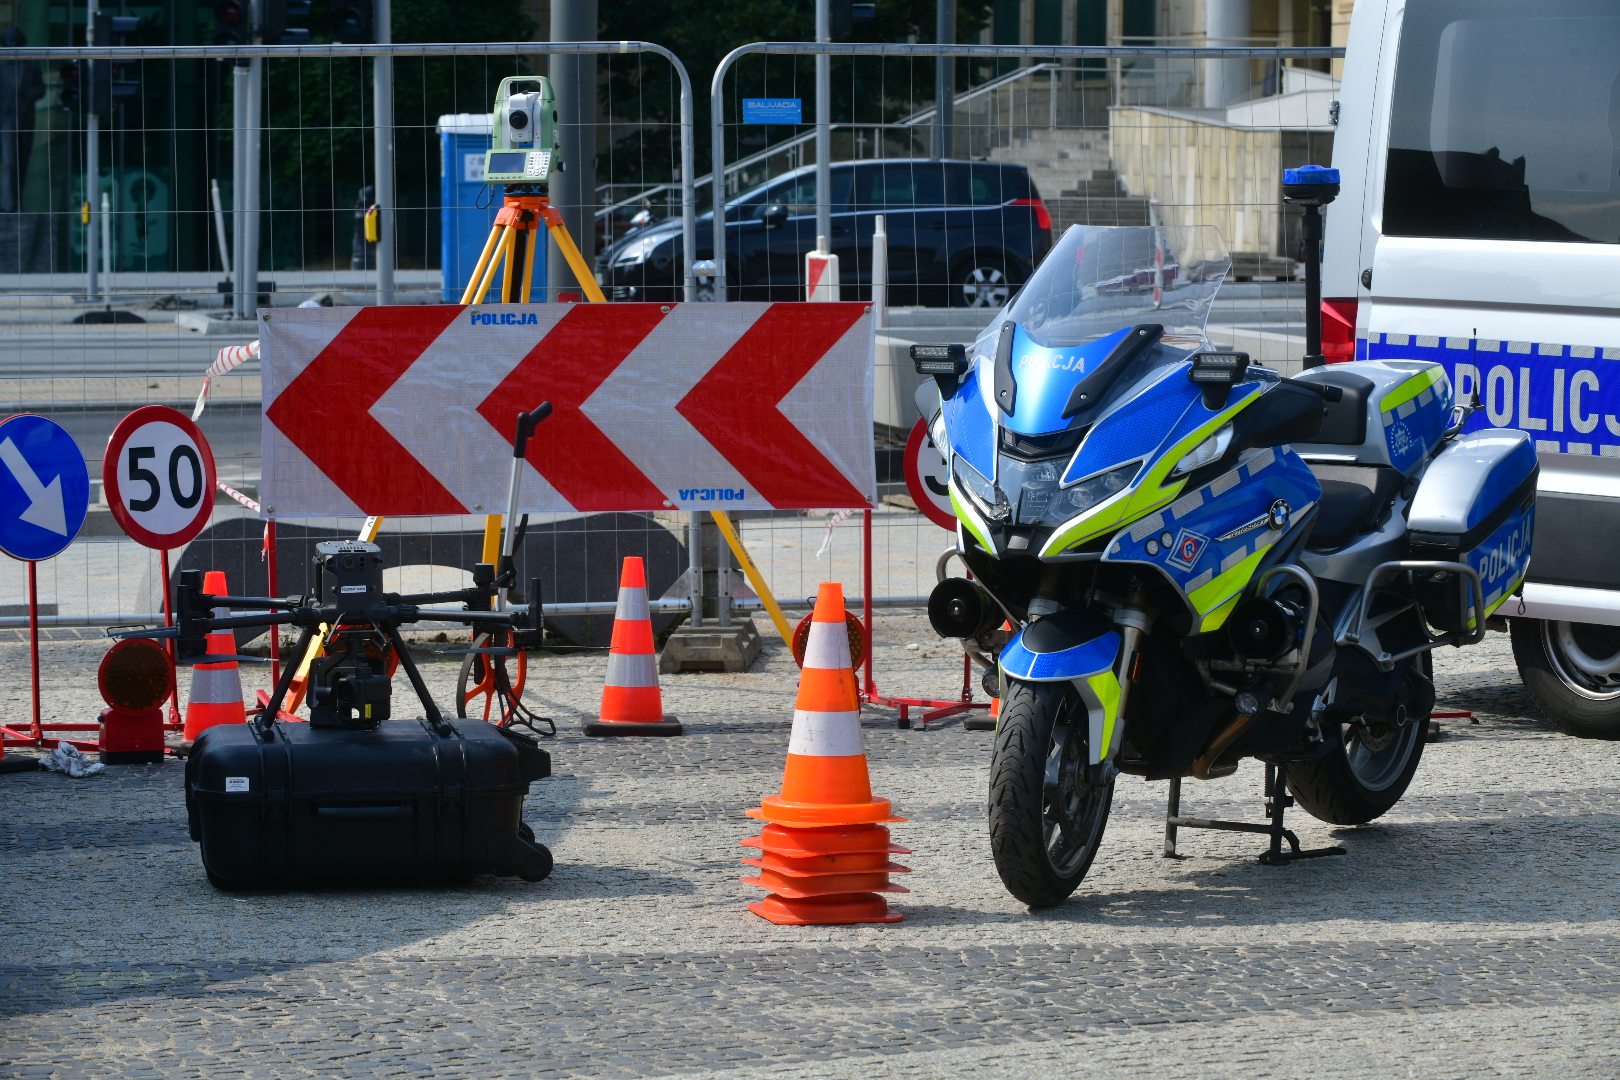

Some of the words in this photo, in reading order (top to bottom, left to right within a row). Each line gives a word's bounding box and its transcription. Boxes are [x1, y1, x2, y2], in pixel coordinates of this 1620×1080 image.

[471, 312, 538, 325] POLICJA
[1018, 354, 1085, 373] POLICJA
[129, 445, 202, 512] 50
[679, 489, 744, 500] POLICJA
[1186, 543, 1194, 557] R
[1479, 514, 1530, 583] POLICJA
